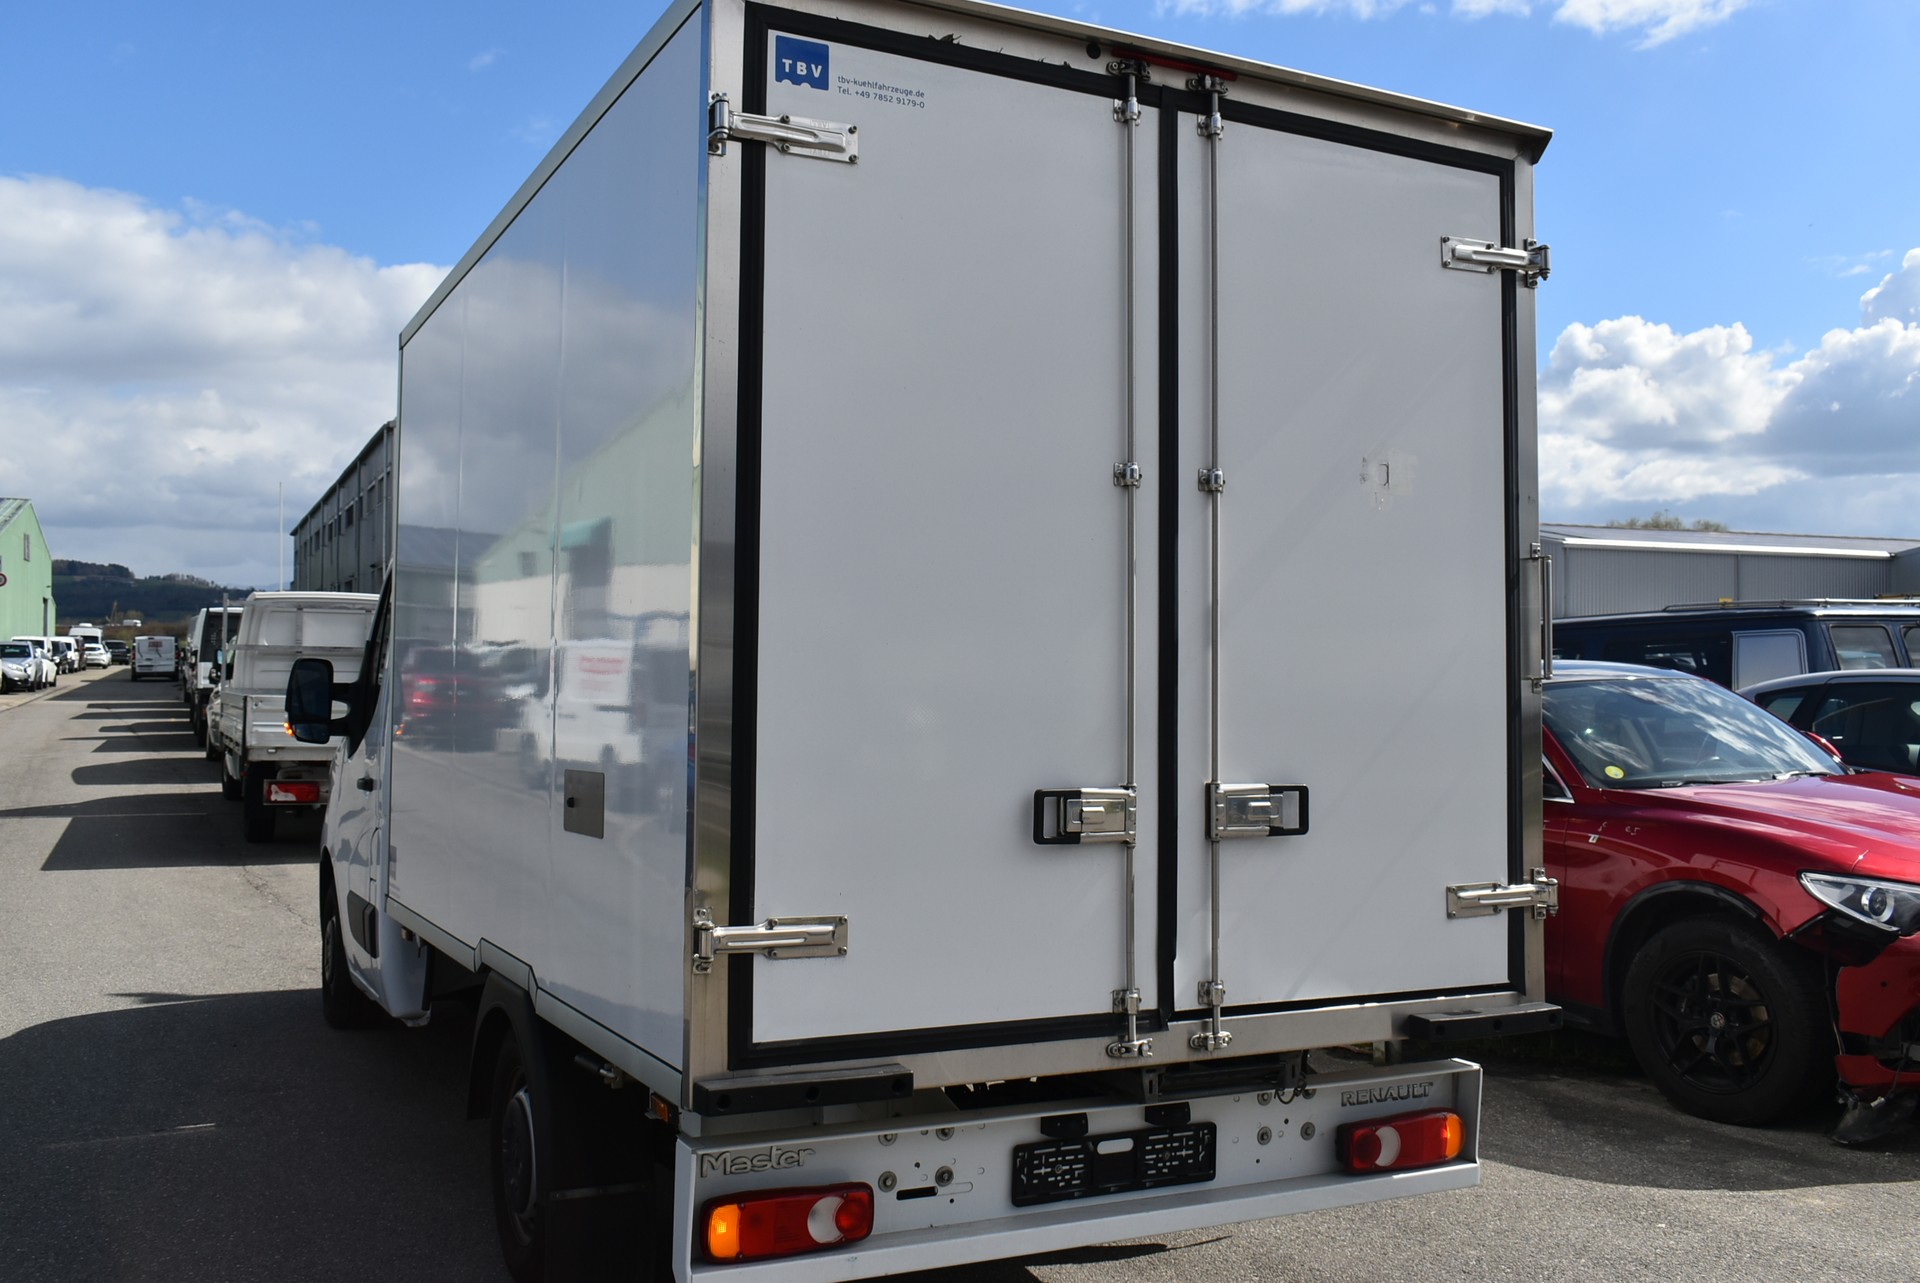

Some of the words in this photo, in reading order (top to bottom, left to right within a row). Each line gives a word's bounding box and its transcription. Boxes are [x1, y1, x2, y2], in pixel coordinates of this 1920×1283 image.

[782, 59, 822, 78] TBV
[837, 76, 925, 98] tbv-kuehlfahrzeuge.de
[837, 86, 852, 96] Tel.
[855, 90, 871, 99] +49
[873, 93, 894, 103] 7852
[896, 97, 925, 108] 9179-0
[1341, 1082, 1433, 1107] RENAULT
[701, 1146, 816, 1178] Master
